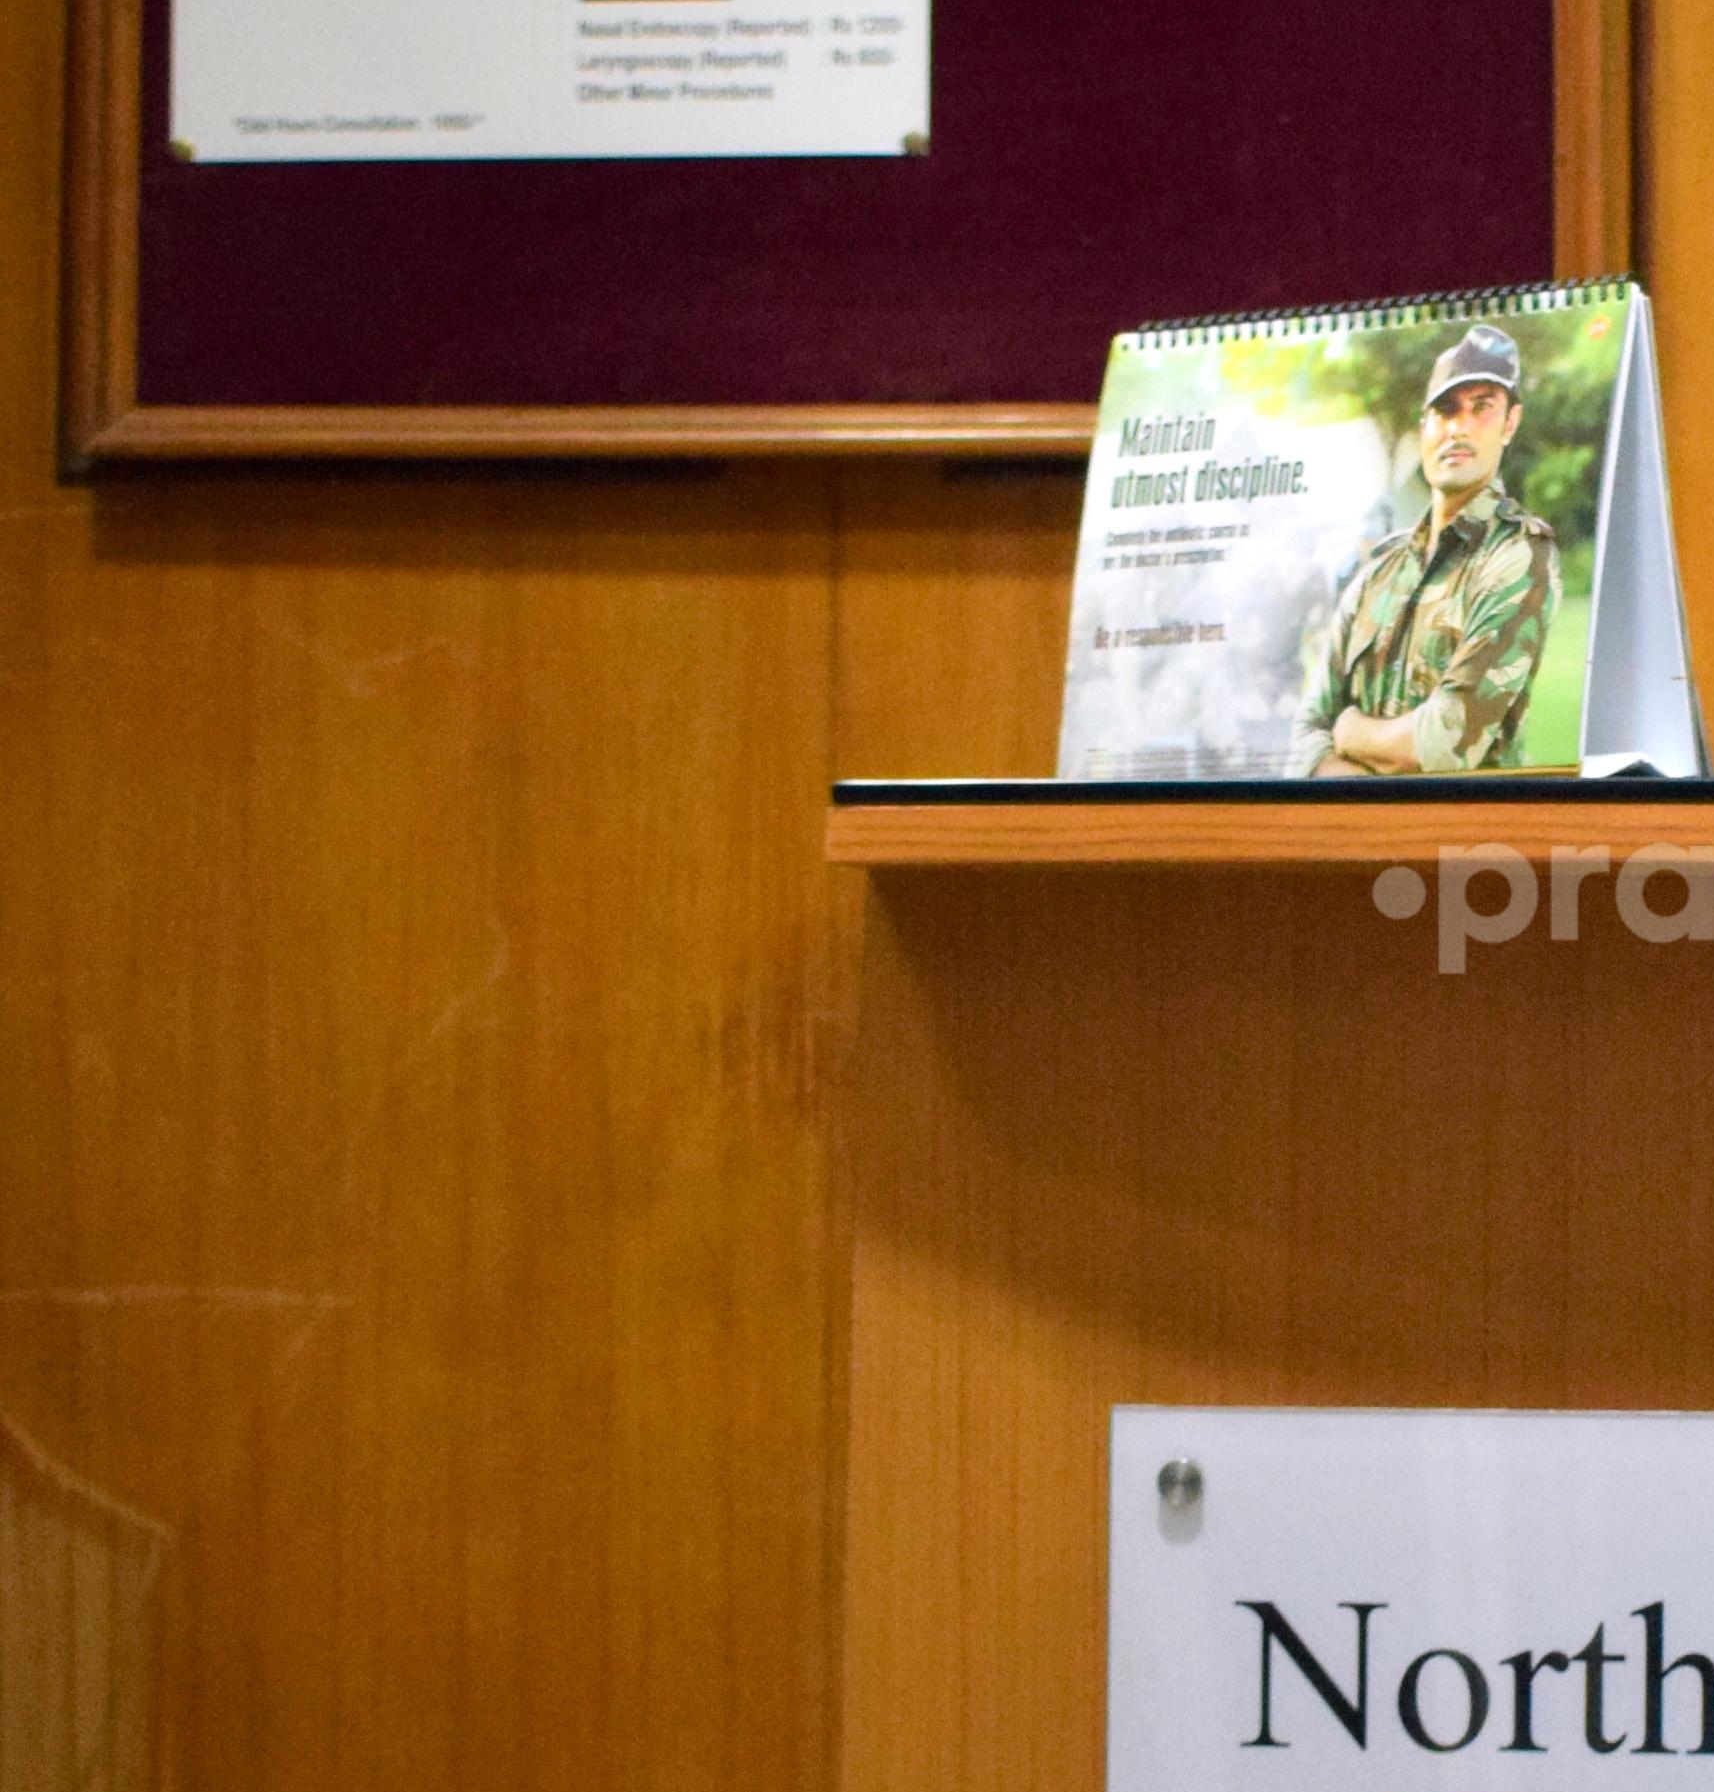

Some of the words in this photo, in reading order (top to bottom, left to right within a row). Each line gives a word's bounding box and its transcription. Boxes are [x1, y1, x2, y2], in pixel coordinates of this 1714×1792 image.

[1118, 411, 1216, 457] Maintain
[1110, 464, 1189, 509] utmost
[1193, 455, 1309, 503] discipline.
